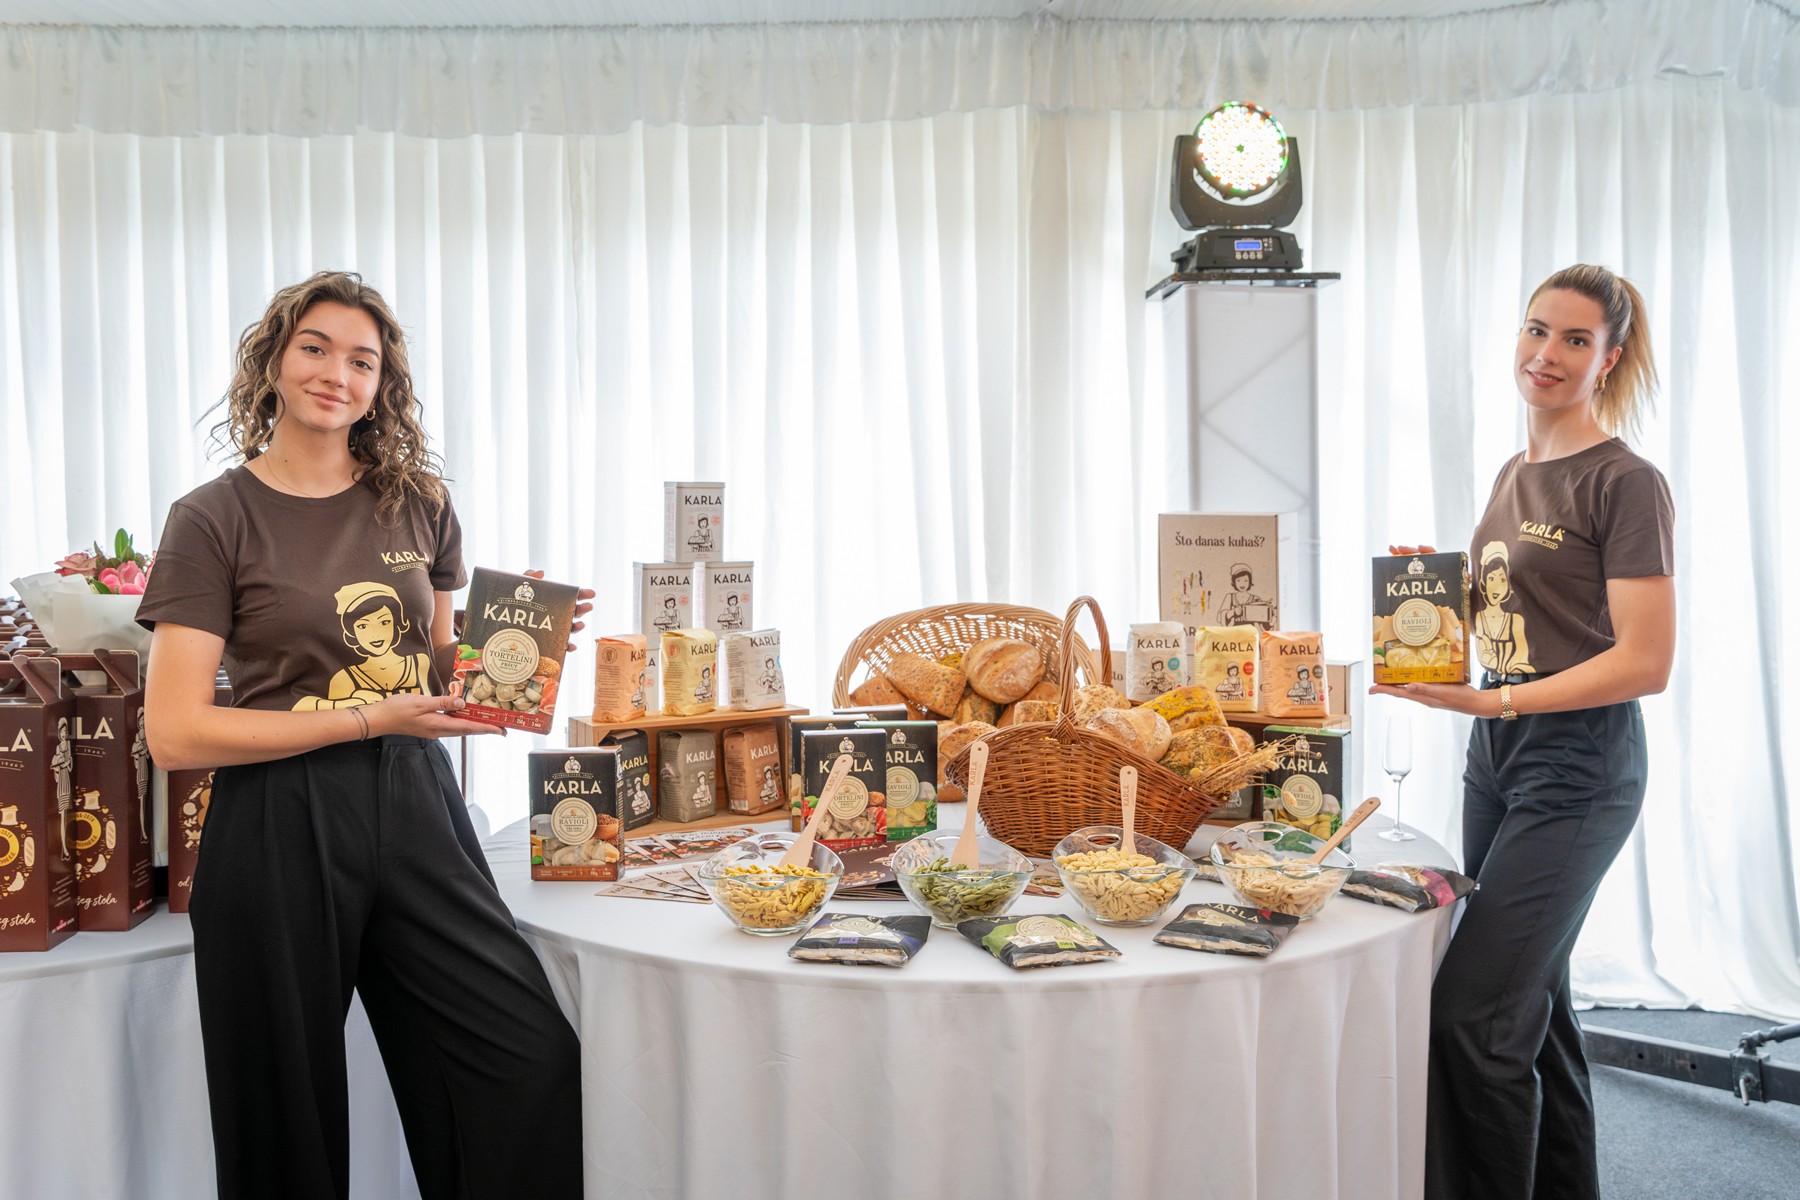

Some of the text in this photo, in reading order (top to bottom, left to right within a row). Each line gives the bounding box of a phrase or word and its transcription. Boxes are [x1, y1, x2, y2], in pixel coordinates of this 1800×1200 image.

[685, 495, 722, 505] KARLA
[1520, 521, 1563, 541] KARLA
[1175, 531, 1265, 547] Što danas kuhaš?
[381, 551, 429, 564] KARLA
[650, 575, 690, 586] KARLA
[714, 573, 751, 584] KARLA
[1387, 580, 1446, 597] KARLA
[483, 603, 553, 631] KARLA
[691, 643, 716, 656] KARLA
[1137, 638, 1180, 649] KARLA
[1212, 641, 1254, 652] KARLA
[1280, 644, 1321, 656] KARLA
[490, 650, 533, 665] TORTELINI
[686, 750, 716, 764] KARLA
[750, 743, 778, 760] KARLA
[886, 750, 925, 764] ARLA
[622, 754, 648, 771] KARLA
[1277, 756, 1329, 775] KARLA
[970, 761, 979, 786] KARLA
[544, 780, 602, 795] KARLA
[92, 893, 117, 906] stola
[10, 912, 37, 927] stola
